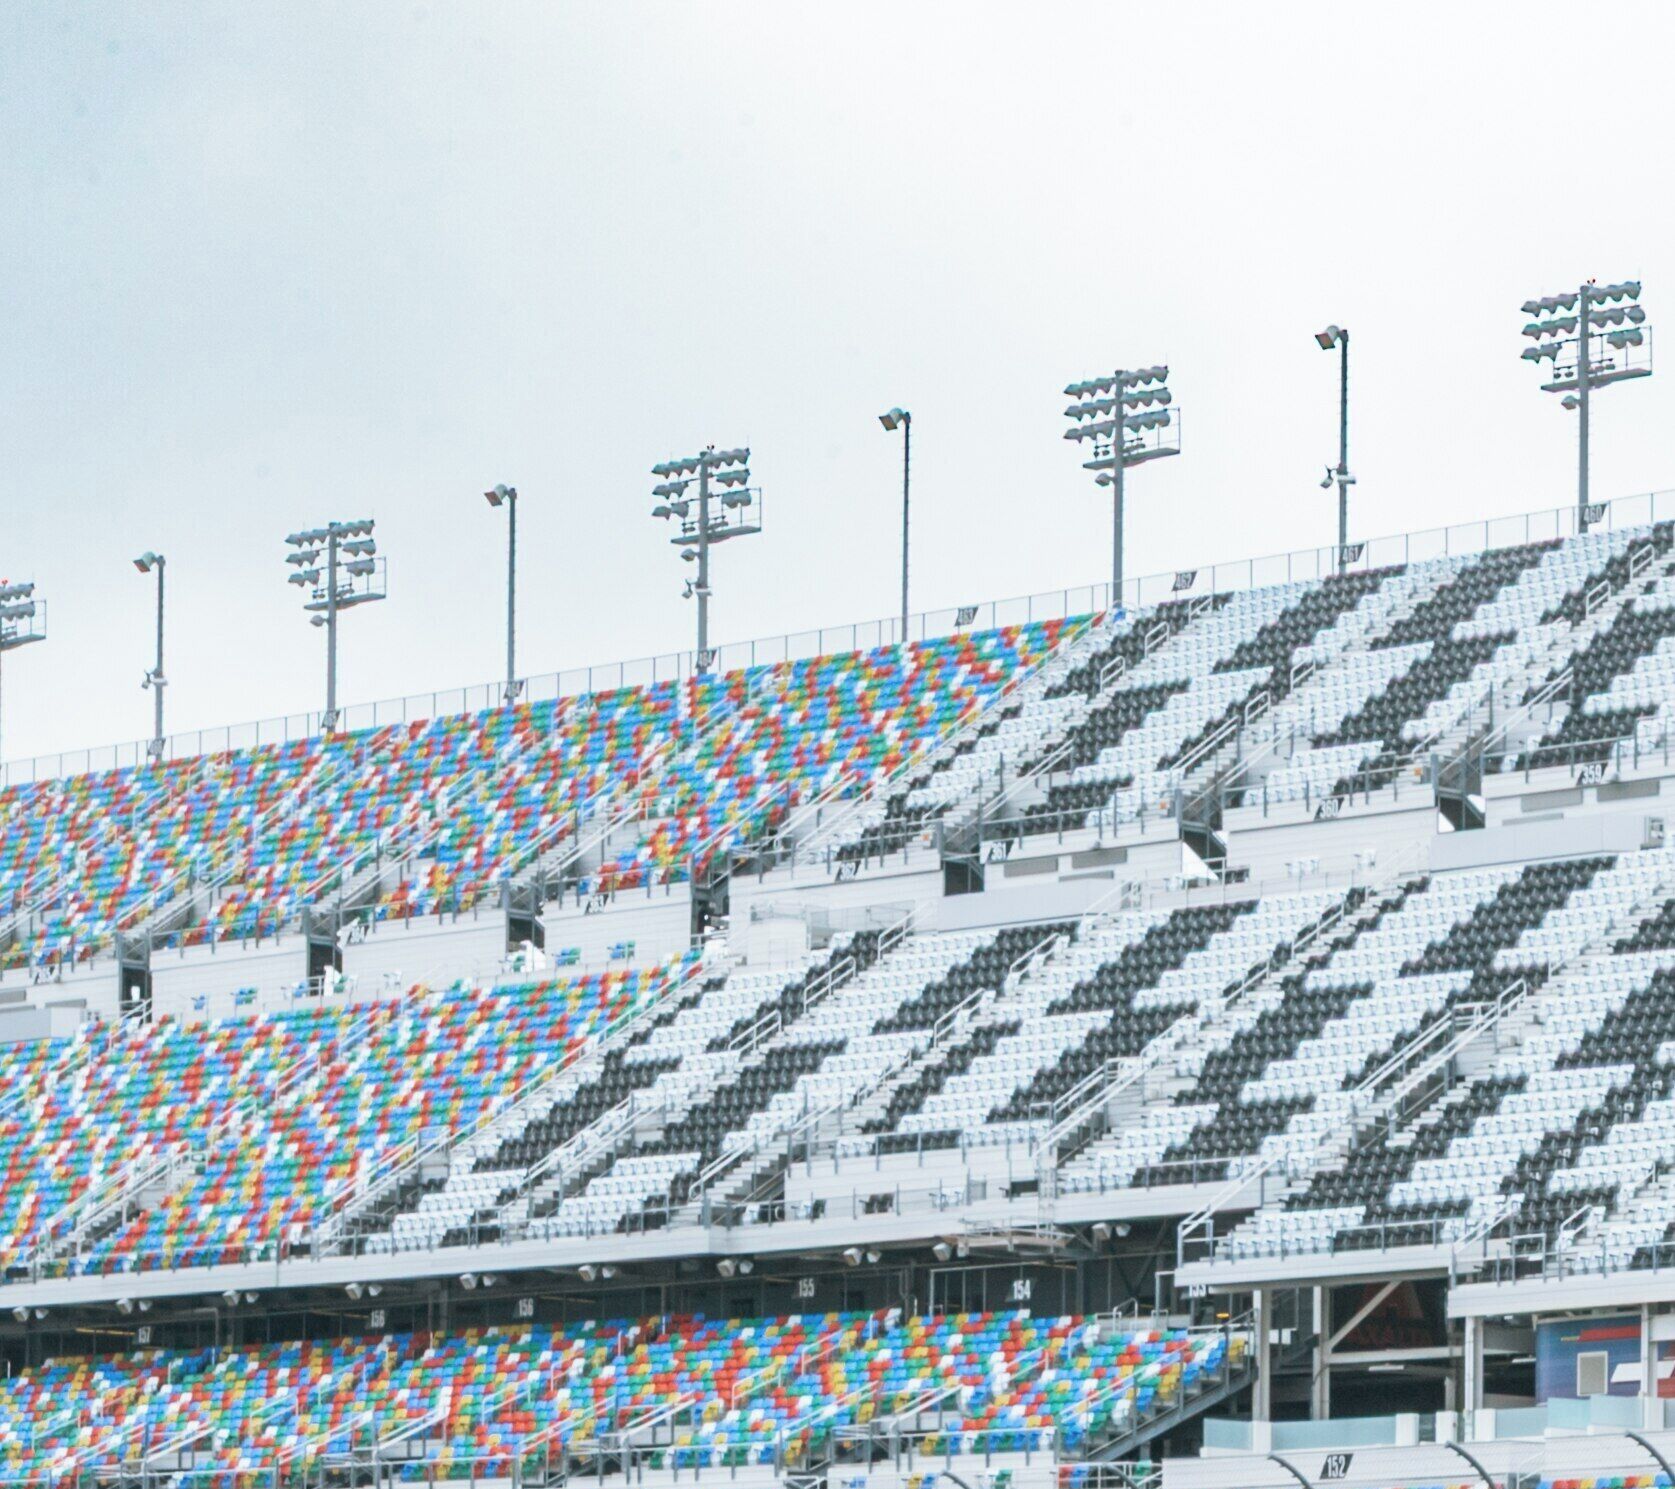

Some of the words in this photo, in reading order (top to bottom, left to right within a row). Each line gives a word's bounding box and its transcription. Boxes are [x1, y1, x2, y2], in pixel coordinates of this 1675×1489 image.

[1582, 764, 1602, 785] 359
[1320, 799, 1338, 818] 360
[799, 1278, 815, 1297] 155
[1013, 1279, 1031, 1300] 154
[1327, 1454, 1346, 1478] 152
